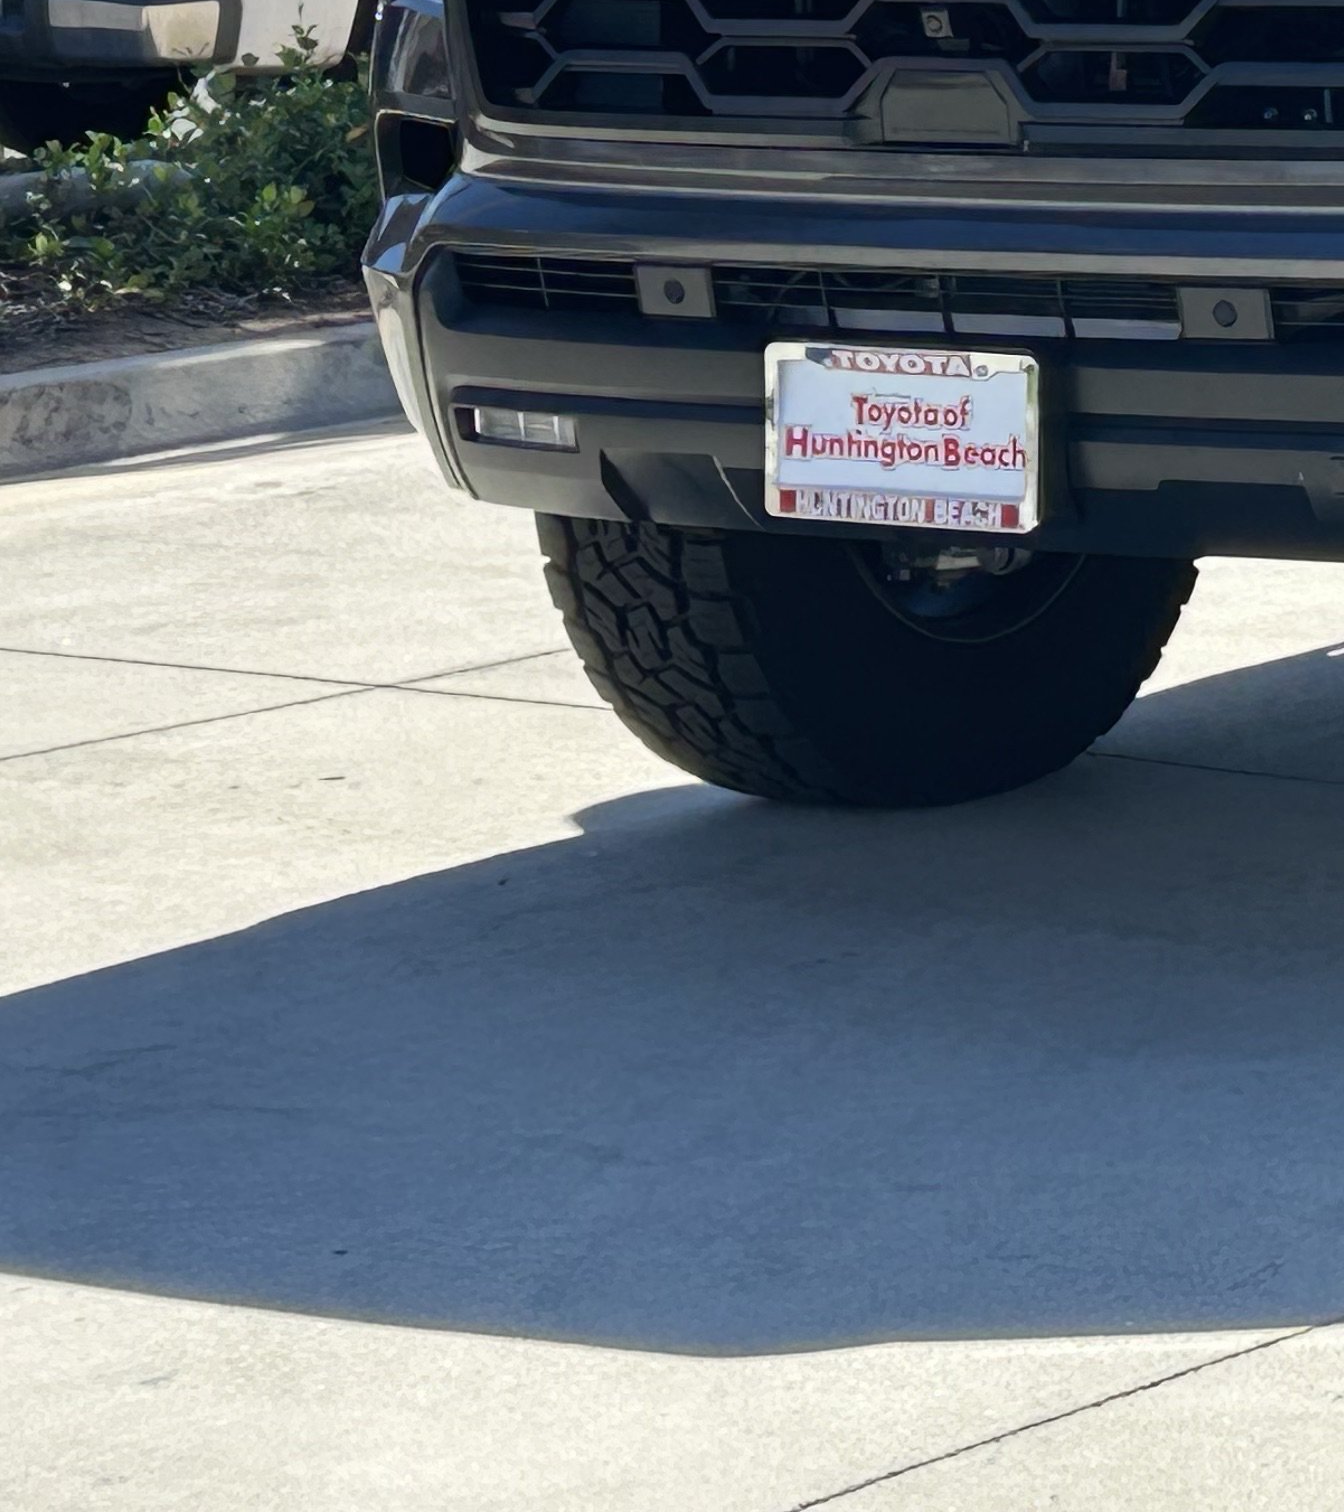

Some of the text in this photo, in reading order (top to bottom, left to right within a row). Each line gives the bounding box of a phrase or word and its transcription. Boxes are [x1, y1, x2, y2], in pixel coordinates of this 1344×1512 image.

[830, 348, 971, 378] TOYOTA
[852, 395, 971, 431] Toyota of
[784, 426, 1027, 468] Huntington Beach
[796, 490, 1002, 528] HUNTINGTON BEACH
